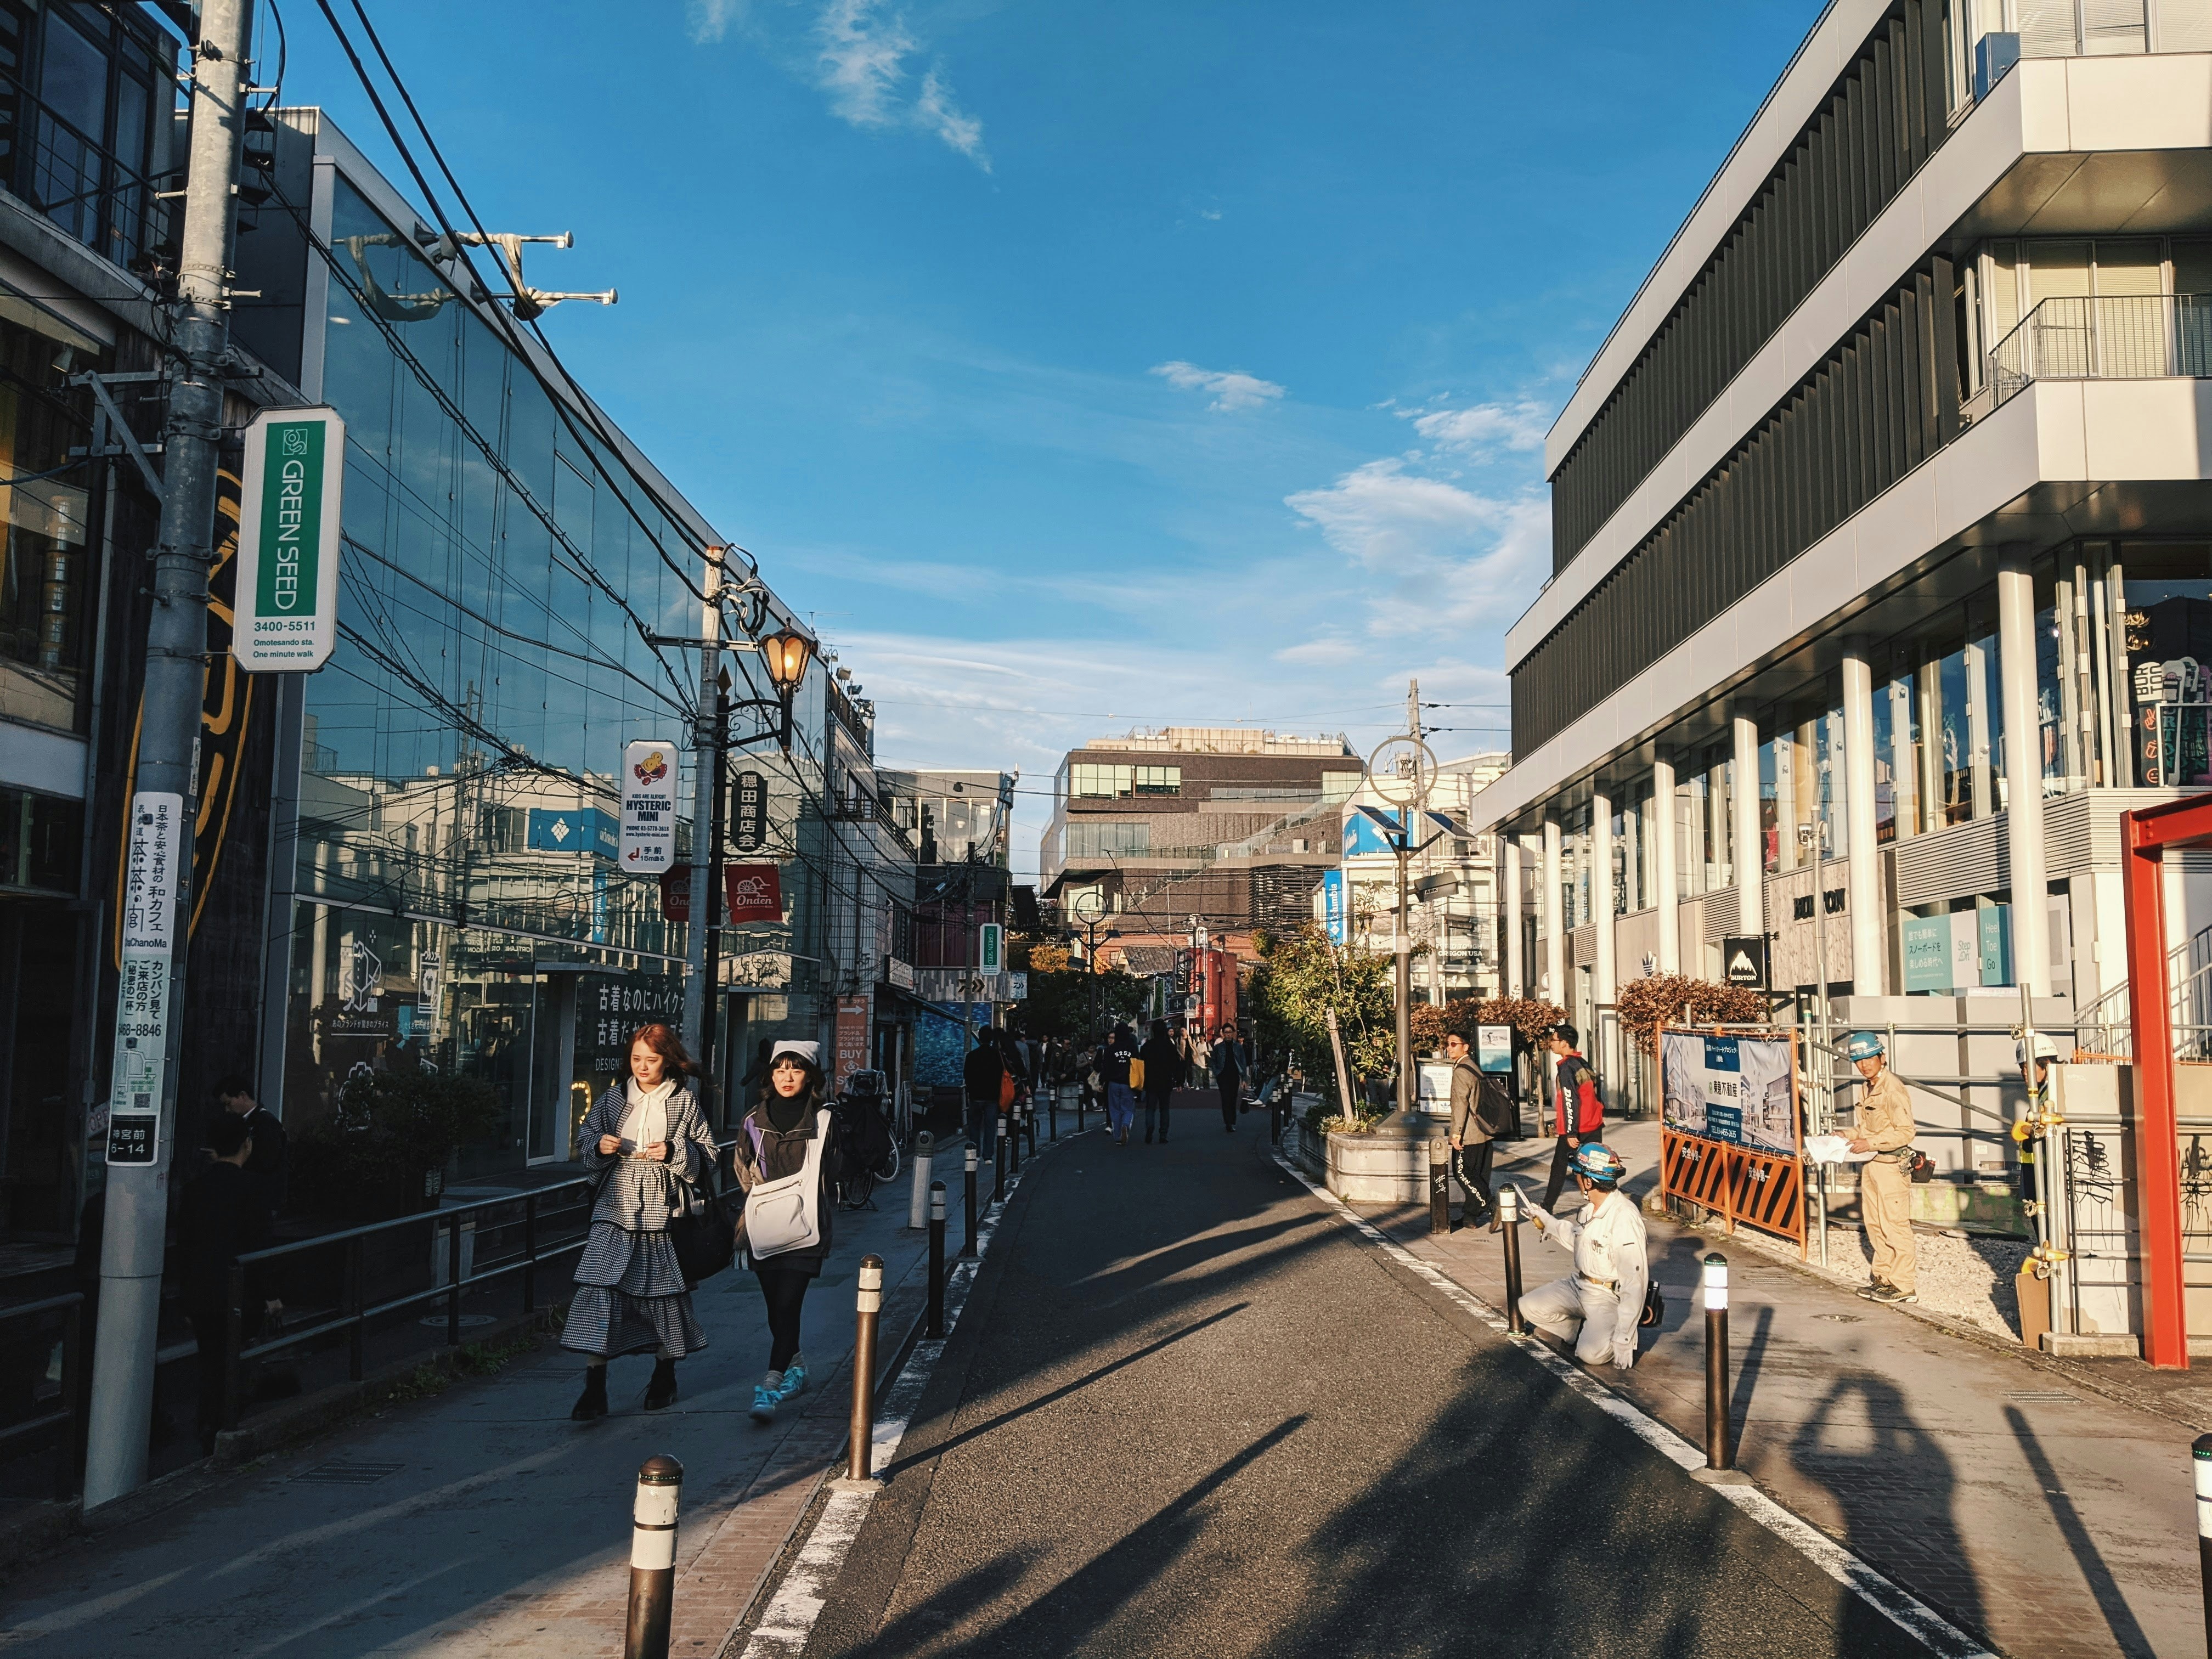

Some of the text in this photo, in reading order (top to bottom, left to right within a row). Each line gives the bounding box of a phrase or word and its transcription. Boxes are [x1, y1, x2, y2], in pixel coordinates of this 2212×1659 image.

[275, 459, 304, 610] GREEN SEED
[254, 621, 315, 632] 3400-5511
[253, 638, 300, 647] Omotesando
[297, 650, 314, 658] walk
[2135, 667, 2149, 696] BUR
[2150, 665, 2163, 695] TON
[626, 800, 671, 811] HYSTERIC
[738, 774, 758, 848] 穏田商店会
[637, 811, 659, 822] MINI
[152, 804, 169, 883] 日本茶と安心食材の
[736, 895, 774, 906] Onden
[148, 885, 166, 932] 和カフェ
[1908, 928, 1937, 941] 誰でも簡単に
[1985, 922, 2000, 934] Heel
[1909, 942, 1941, 955] スノーボードを
[1957, 940, 1971, 953] Step
[1985, 940, 1997, 952] Toe
[1909, 956, 1944, 969] 楽しめる時代へ
[1987, 958, 1996, 969] Go
[136, 960, 149, 1011] ご来店の方
[149, 960, 163, 1019] カンバン見て
[840, 1049, 862, 1059] BUY
[1713, 1081, 1738, 1097] 東急不動産
[113, 1129, 145, 1141] 神宮前
[111, 1143, 145, 1154] 6-14
